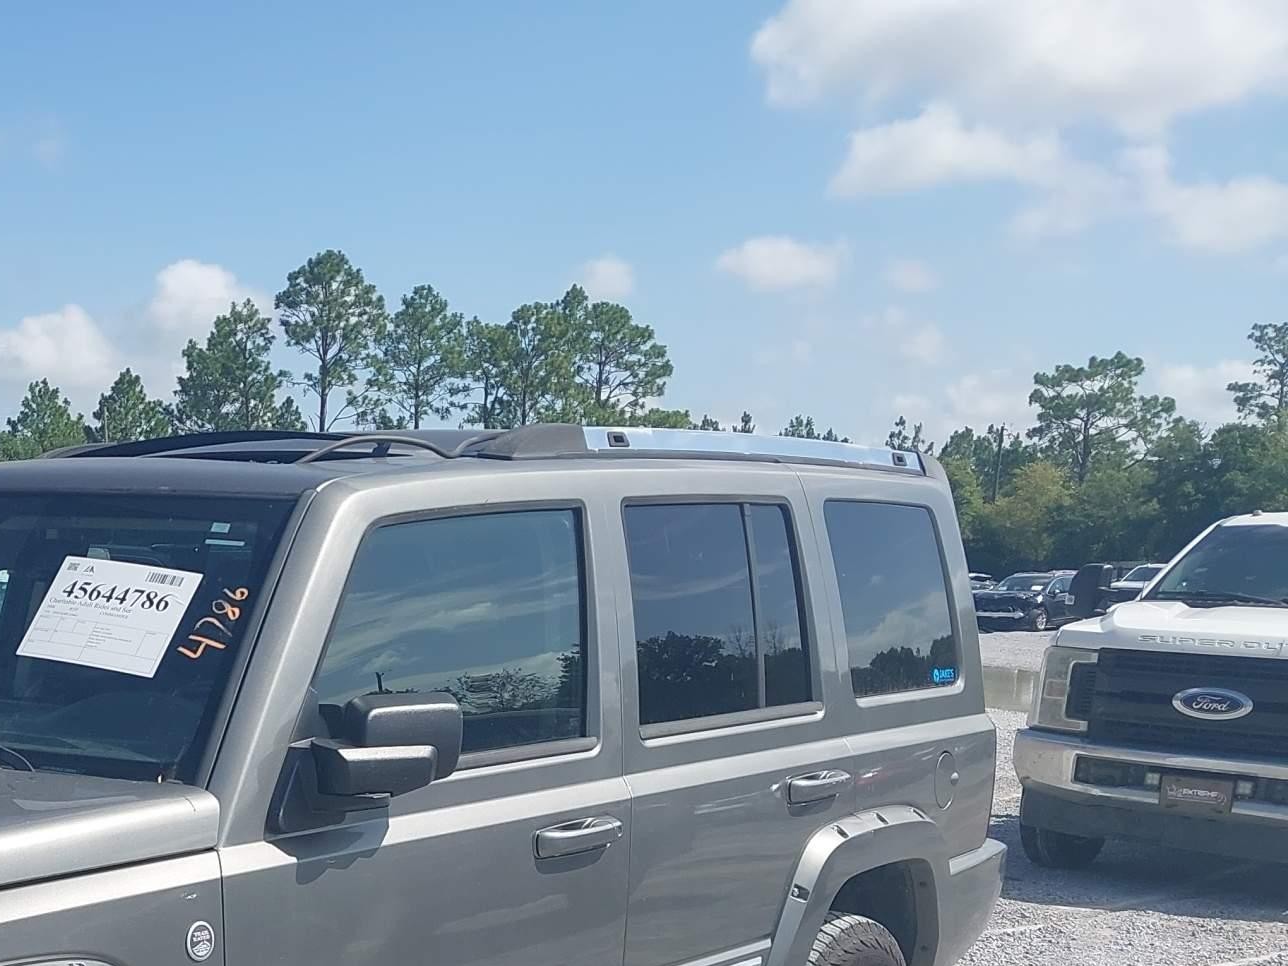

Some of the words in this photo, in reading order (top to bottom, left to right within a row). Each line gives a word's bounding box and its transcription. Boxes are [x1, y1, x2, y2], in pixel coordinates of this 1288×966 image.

[62, 580, 172, 611] 45644786
[177, 588, 249, 658] 4786
[1138, 635, 1235, 648] SUPER
[1192, 695, 1230, 711] Ford
